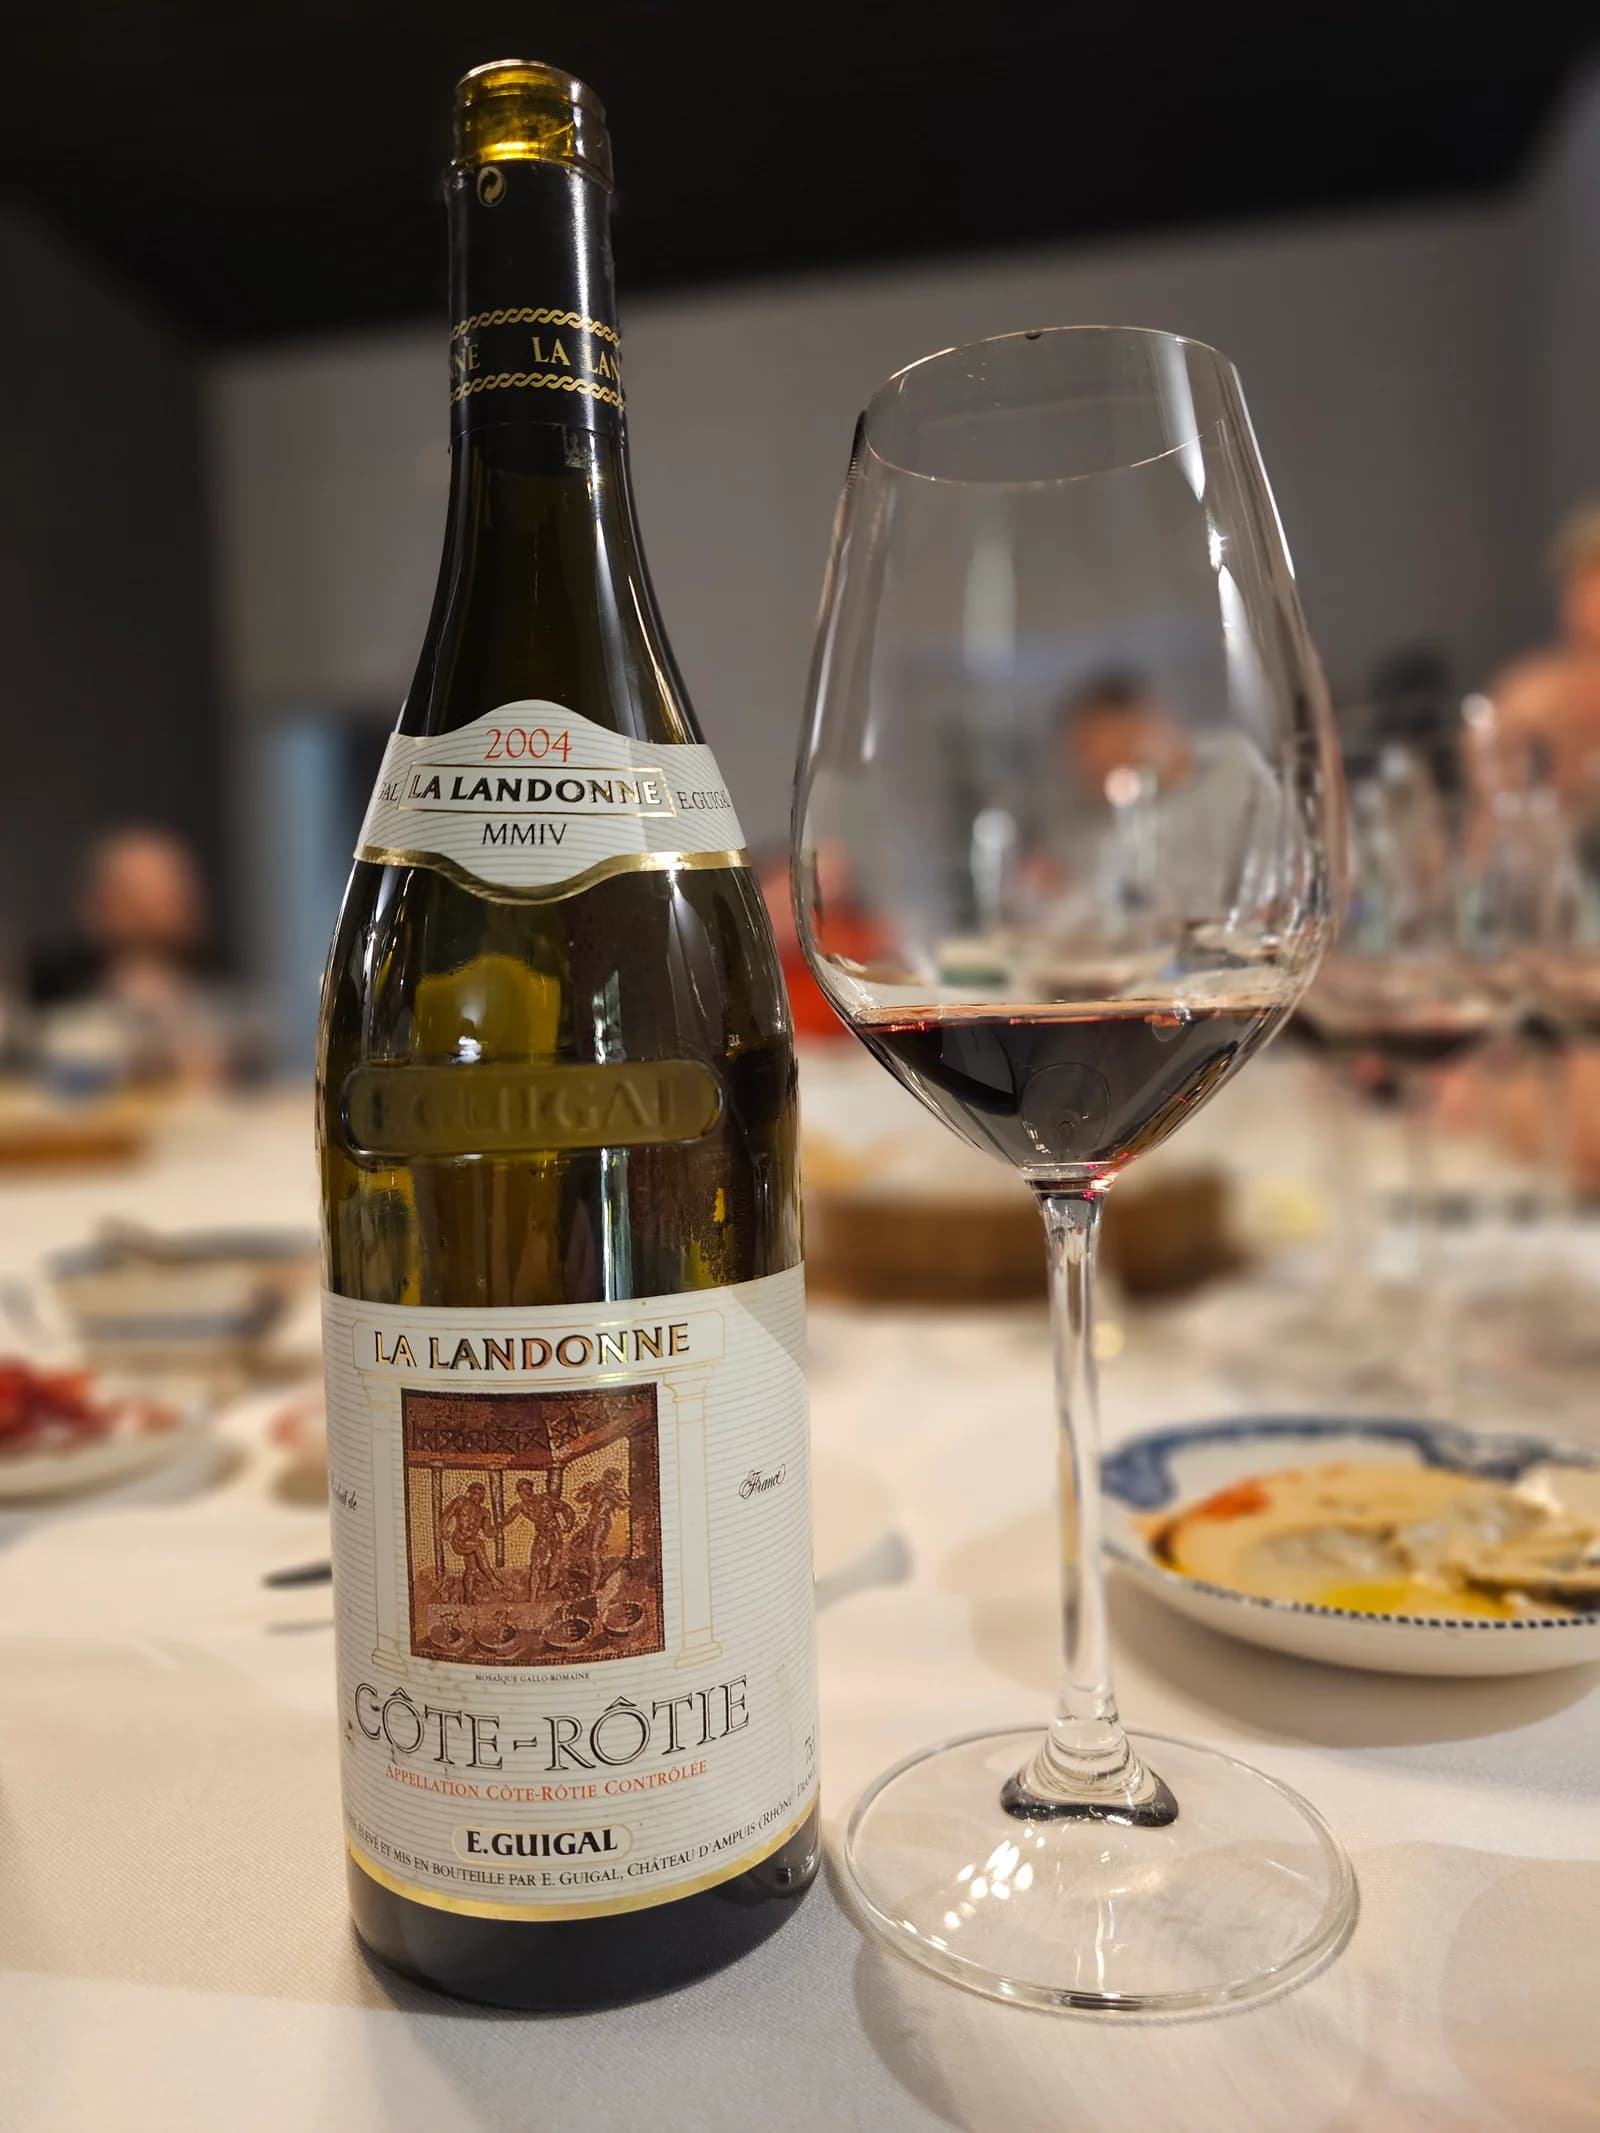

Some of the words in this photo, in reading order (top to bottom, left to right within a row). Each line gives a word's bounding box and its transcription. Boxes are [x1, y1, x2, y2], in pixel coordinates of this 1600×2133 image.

[531, 337, 571, 366] LA
[484, 728, 572, 762] 2004
[408, 774, 441, 799] LA
[449, 775, 661, 806] LANDONNE
[482, 822, 567, 846] MMIV
[375, 1331, 417, 1367] LA
[429, 1323, 690, 1370] LANDONNE
[386, 1763, 479, 1798] APPELLATION
[486, 1783, 597, 1801] CÔTE-RÔTIE
[604, 1760, 707, 1795] CONTRÔLÉE
[380, 1841, 392, 1857] ET
[394, 1848, 412, 1865] MIS
[415, 1857, 429, 1872] EN
[433, 1863, 504, 1885] BOUTEILLE
[509, 1874, 536, 1886] PAR
[542, 1873, 555, 1886] E.
[560, 1869, 623, 1886] GUIGAL,
[628, 1851, 696, 1877] CHÂTEAU
[699, 1824, 756, 1858] D'AMPUIS
[466, 1829, 618, 1857] E.GUIGAL
